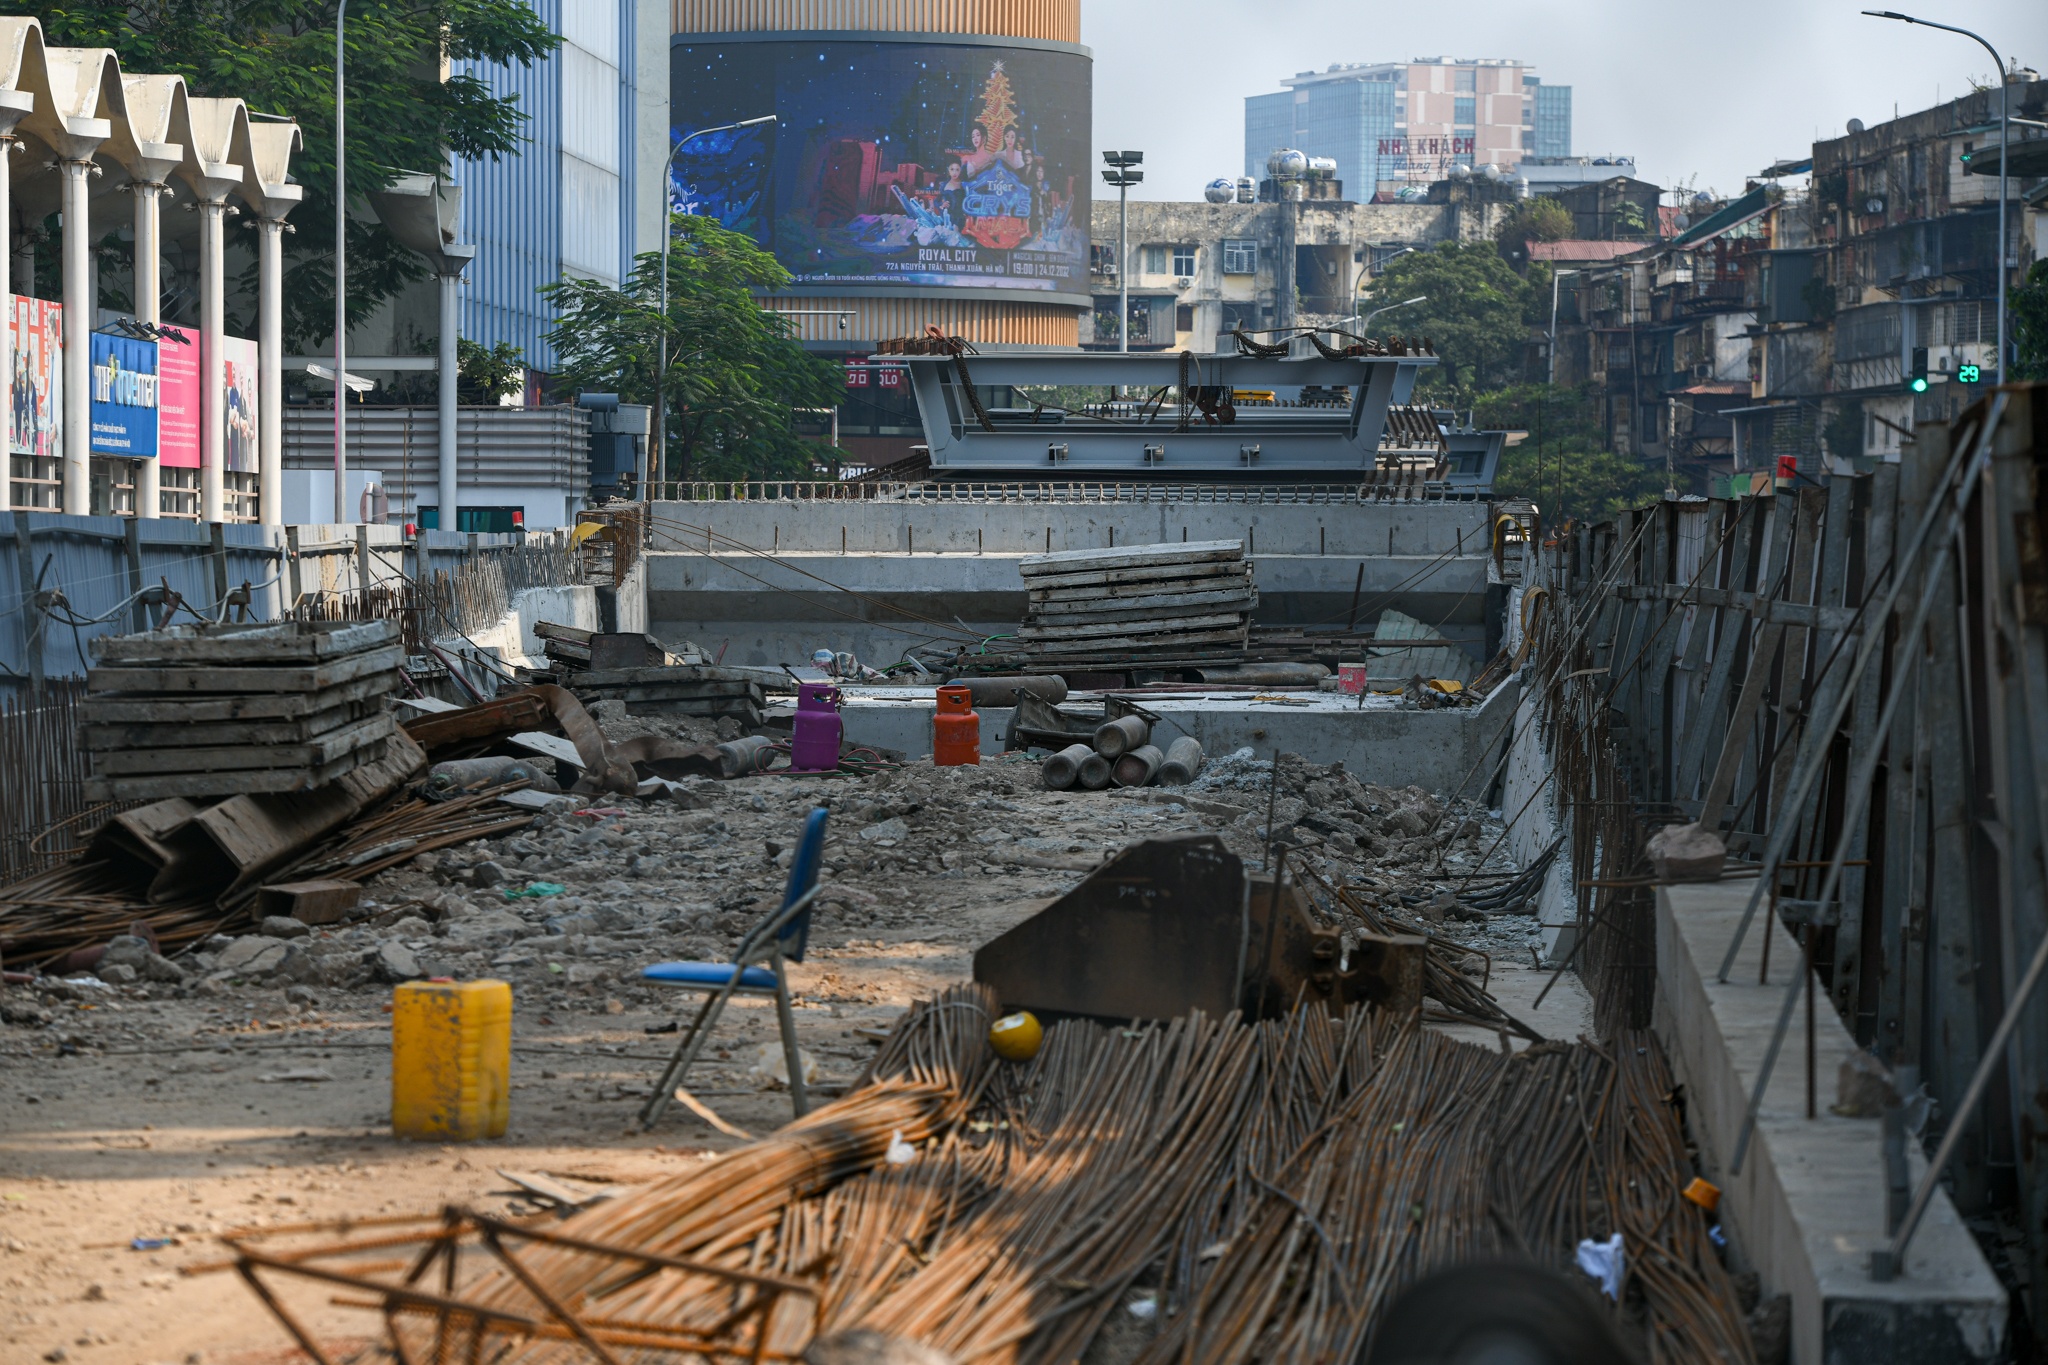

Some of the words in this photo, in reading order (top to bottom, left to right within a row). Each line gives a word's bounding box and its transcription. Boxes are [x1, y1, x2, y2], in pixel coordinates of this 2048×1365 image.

[1378, 135, 1410, 155] NHÀ
[1417, 134, 1475, 155] KHÁCH
[987, 180, 1013, 196] Tiger
[962, 194, 1032, 217] CRYS
[918, 248, 951, 263] ROYAL
[955, 249, 977, 263] CITY
[886, 262, 899, 271] 72A
[900, 260, 926, 271] NGUYỄN
[1013, 262, 1033, 275] 19:00
[1959, 365, 1979, 383] 29
[93, 365, 111, 402] TH
